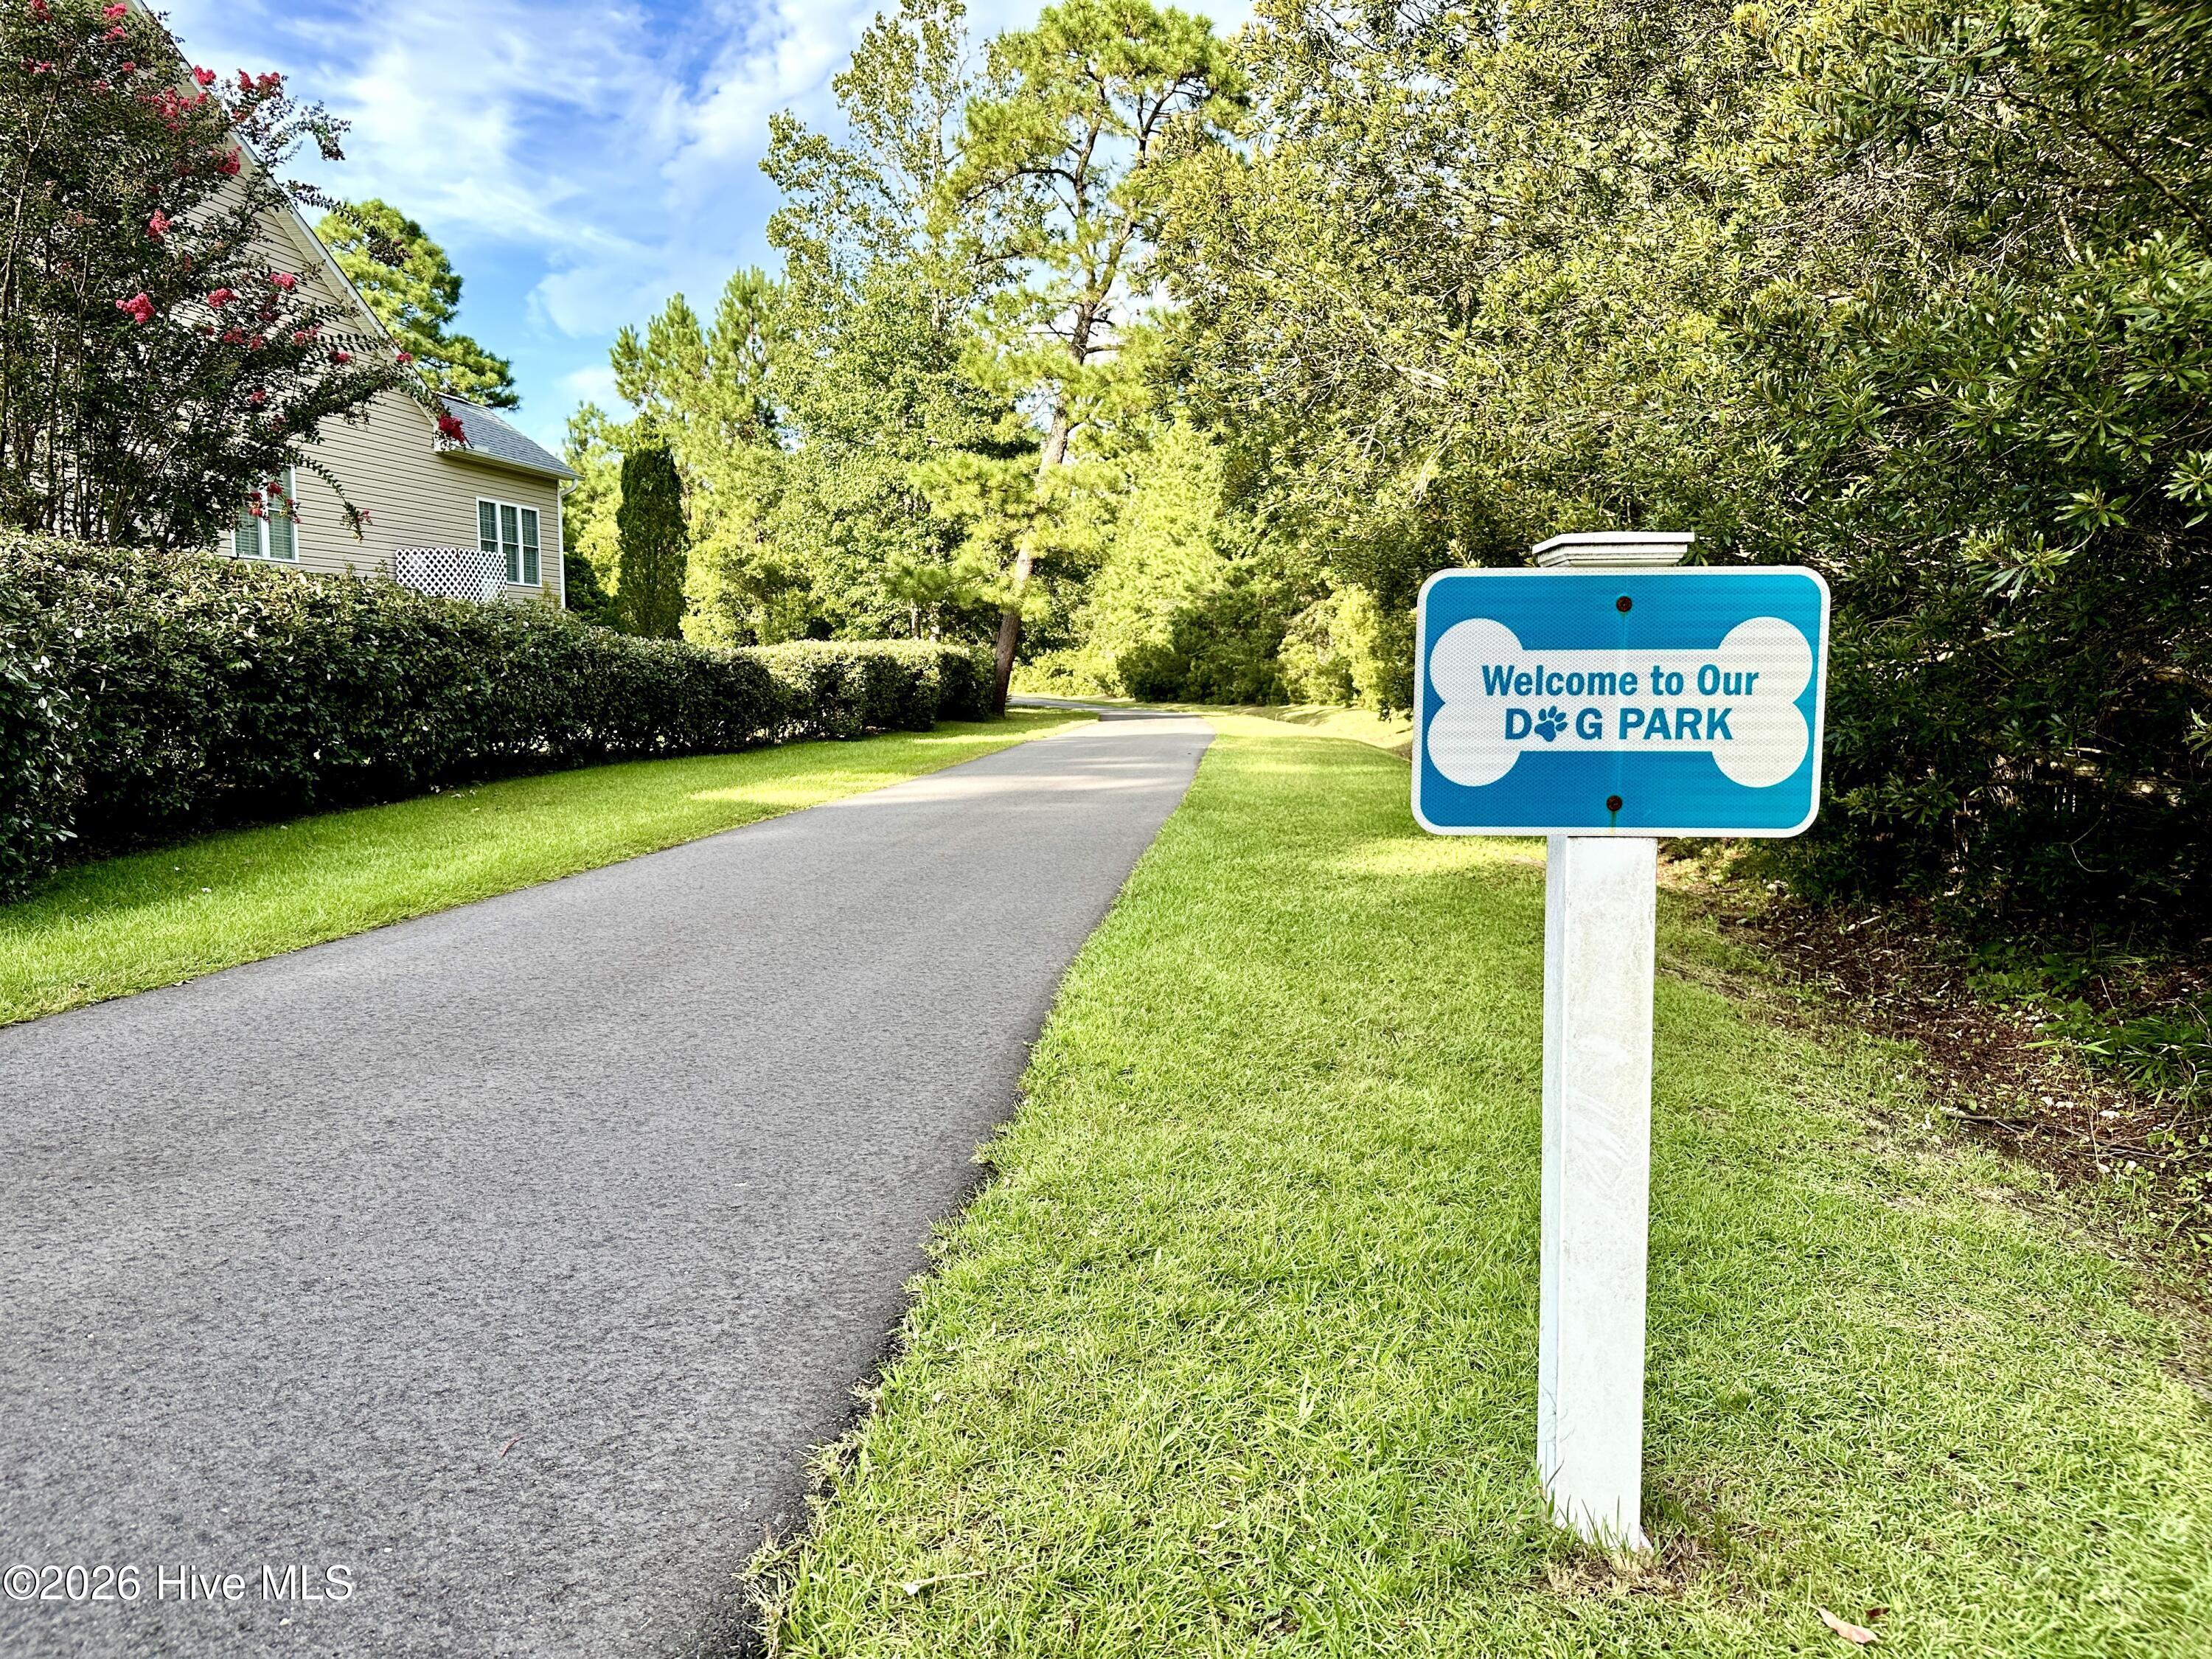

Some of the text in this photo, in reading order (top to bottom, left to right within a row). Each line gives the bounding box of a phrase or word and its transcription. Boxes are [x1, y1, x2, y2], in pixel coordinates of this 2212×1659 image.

[1481, 664, 1759, 697] Welcome to Our
[1618, 707, 1734, 741] PARK
